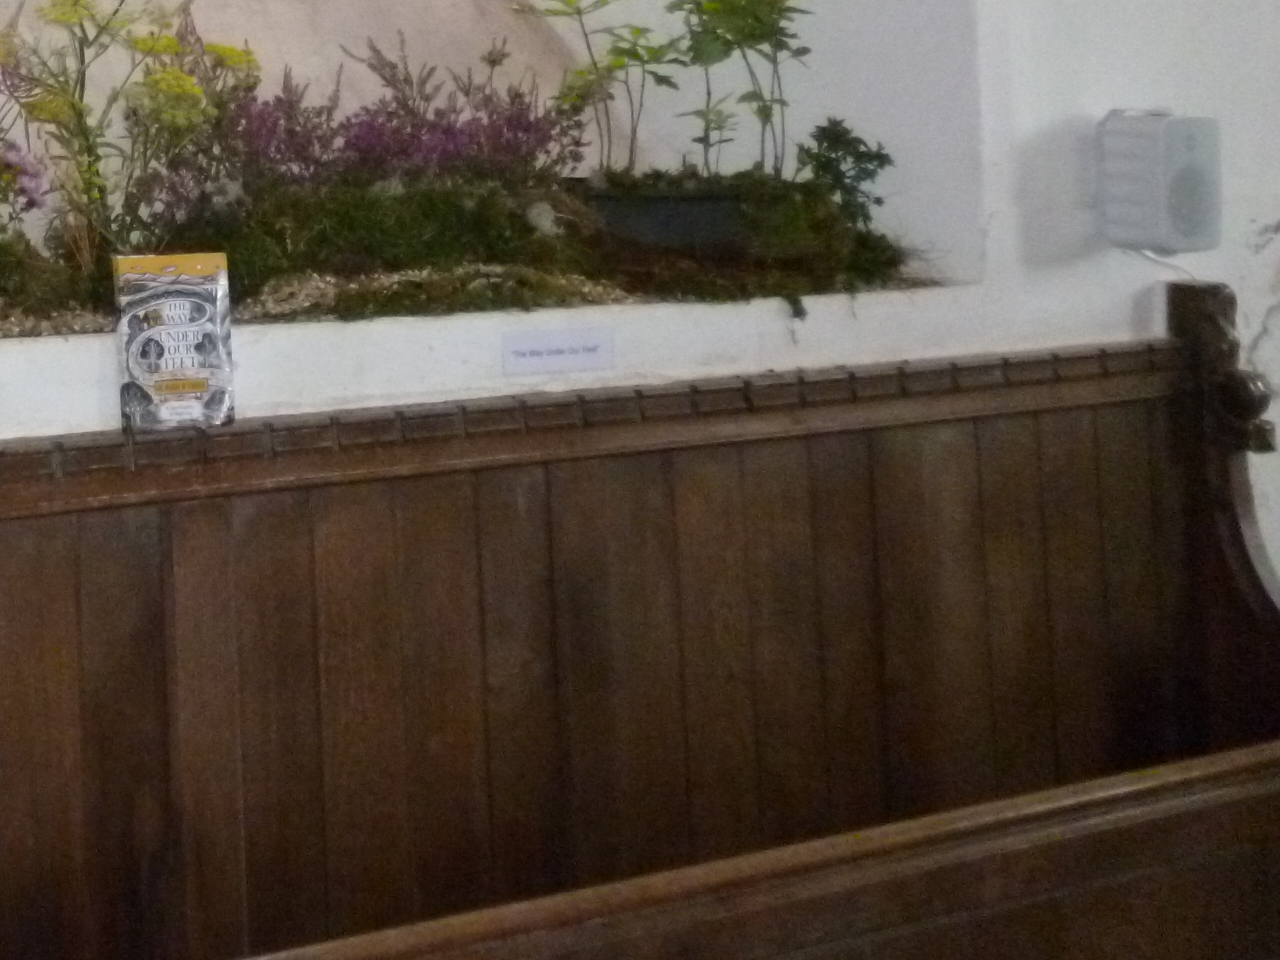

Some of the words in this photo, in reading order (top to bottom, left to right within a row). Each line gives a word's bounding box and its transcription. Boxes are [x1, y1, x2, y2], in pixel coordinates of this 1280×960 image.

[166, 313, 187, 323] WAY
[159, 330, 200, 343] UNDER
[168, 344, 192, 355] OUR
